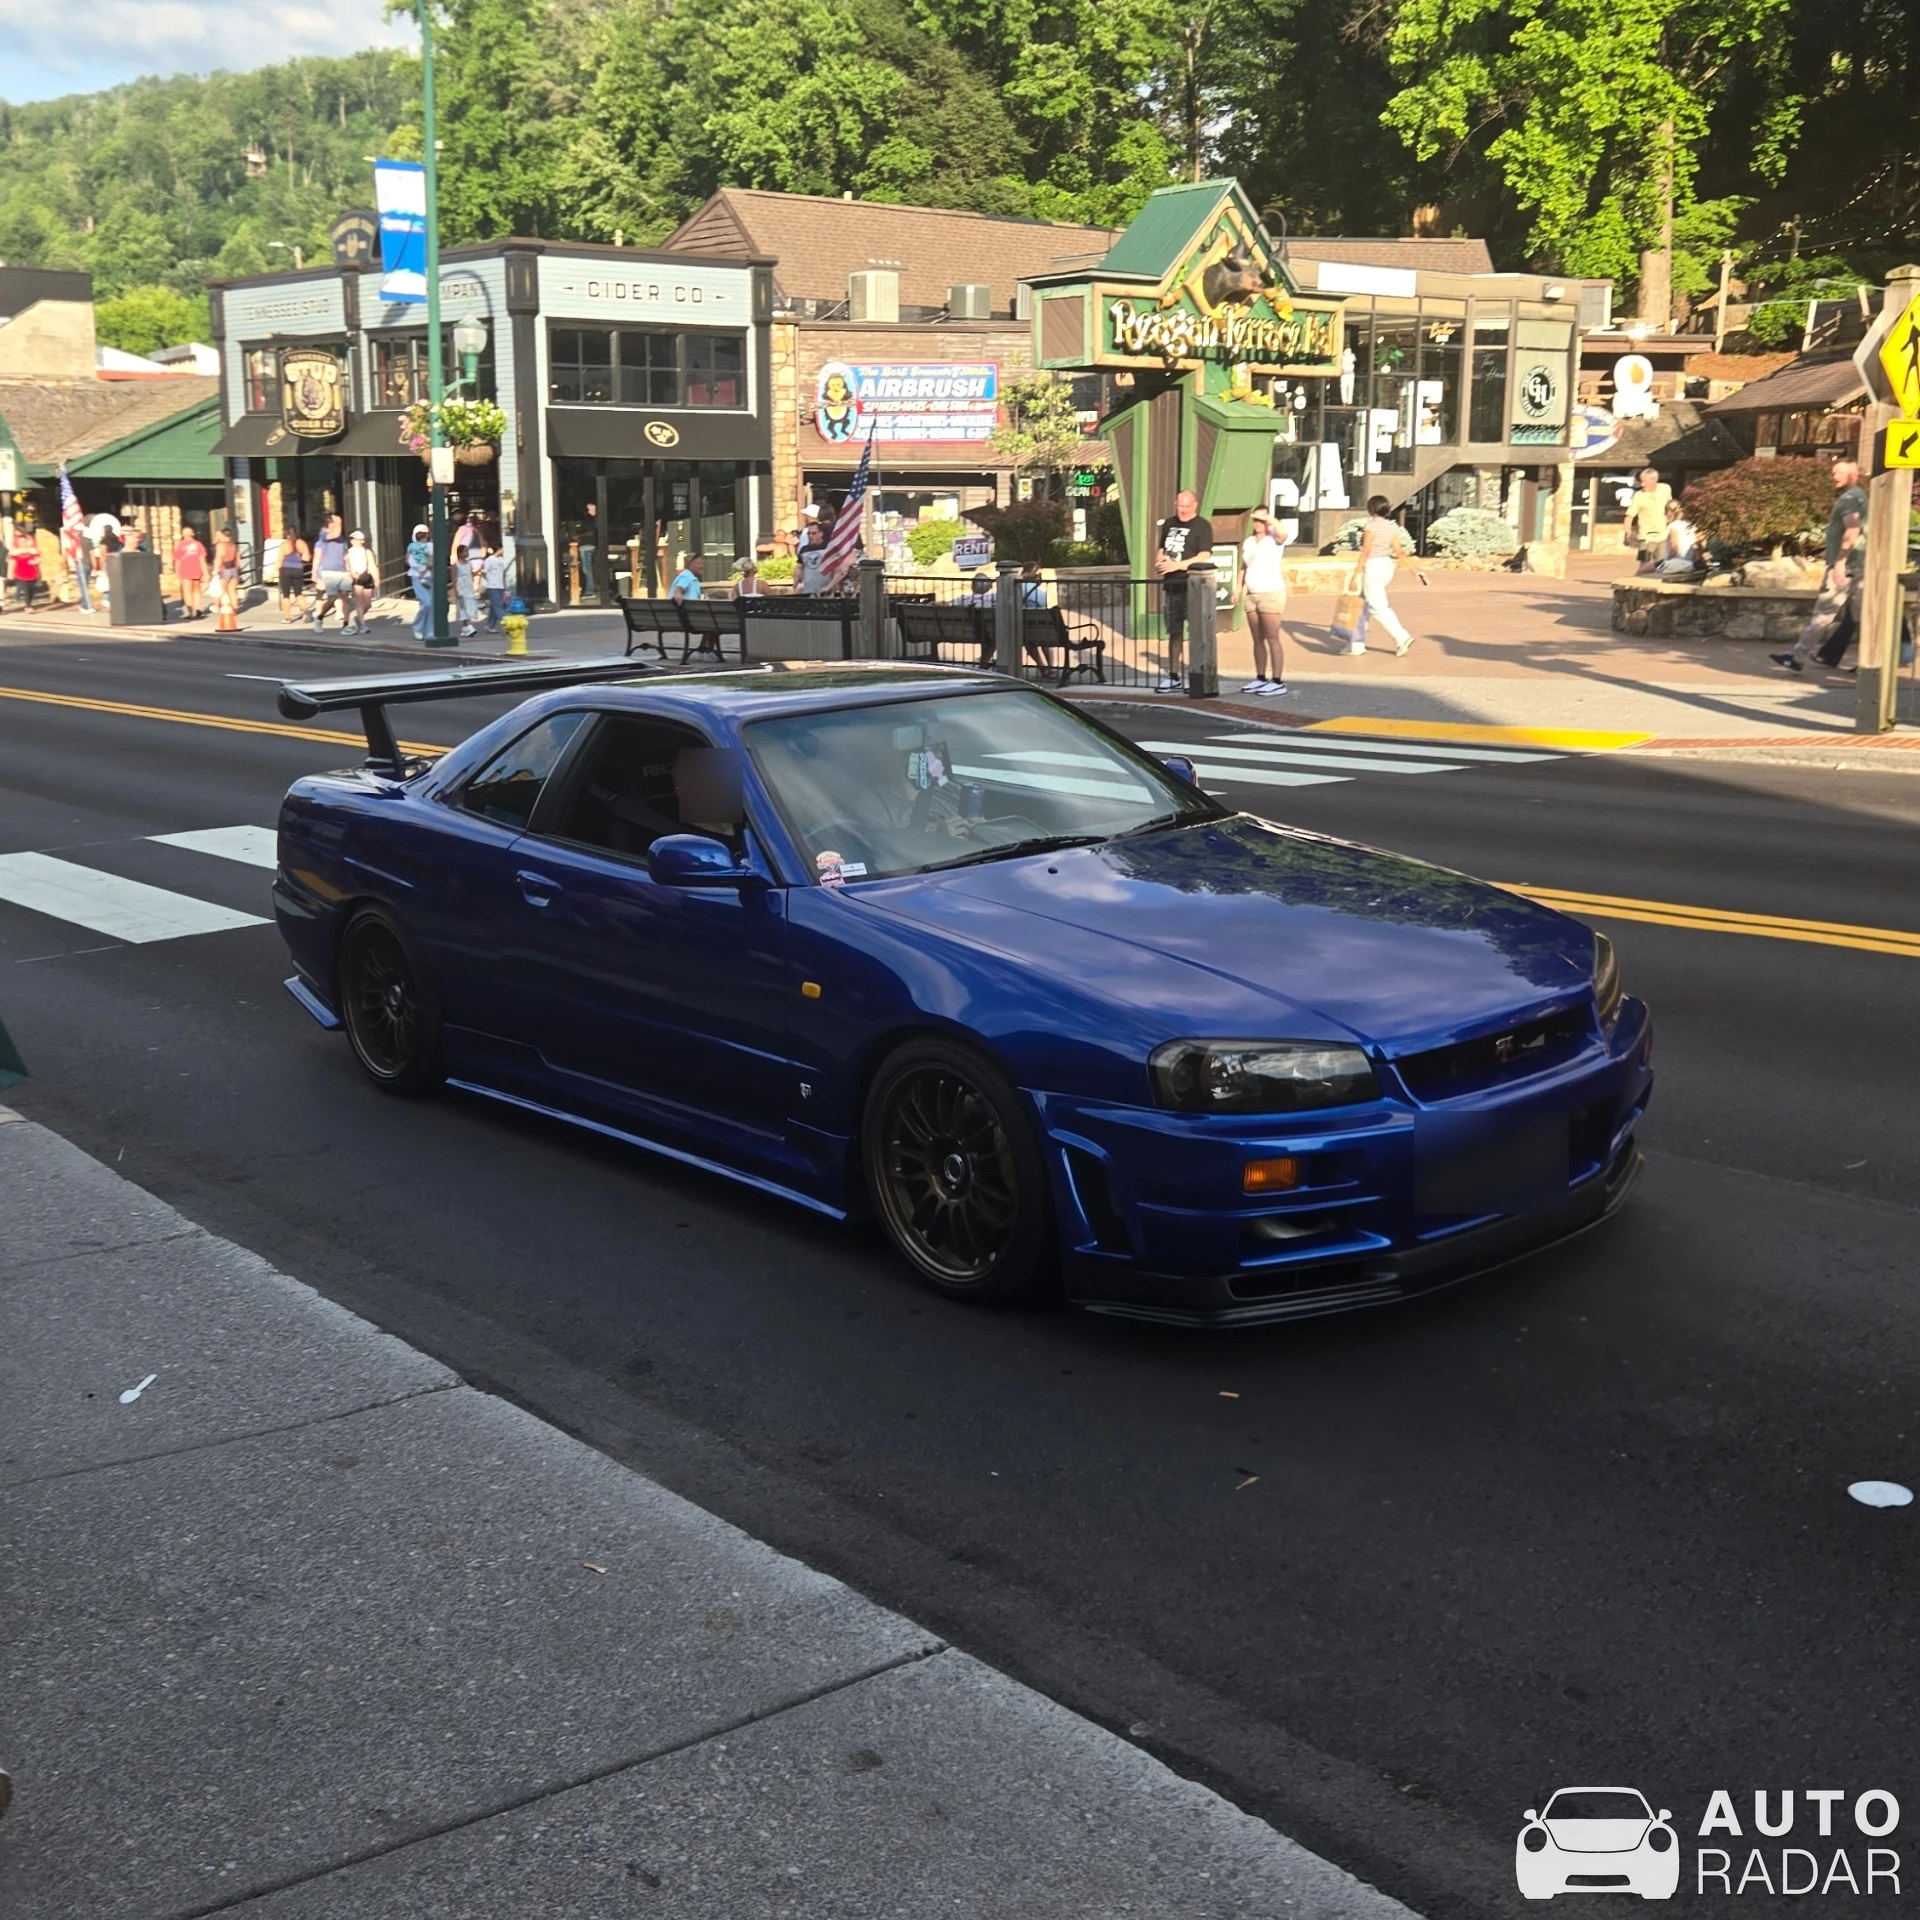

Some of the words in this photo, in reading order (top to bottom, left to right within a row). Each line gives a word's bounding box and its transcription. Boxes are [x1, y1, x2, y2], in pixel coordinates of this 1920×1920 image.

[588, 281, 660, 300] CIDER
[674, 286, 703, 303] CO
[241, 302, 299, 321] TENNESSEE
[302, 298, 329, 316] STUD
[284, 361, 338, 383] STUD
[859, 378, 986, 398] AIRBRUSH
[955, 542, 989, 555] RENT
